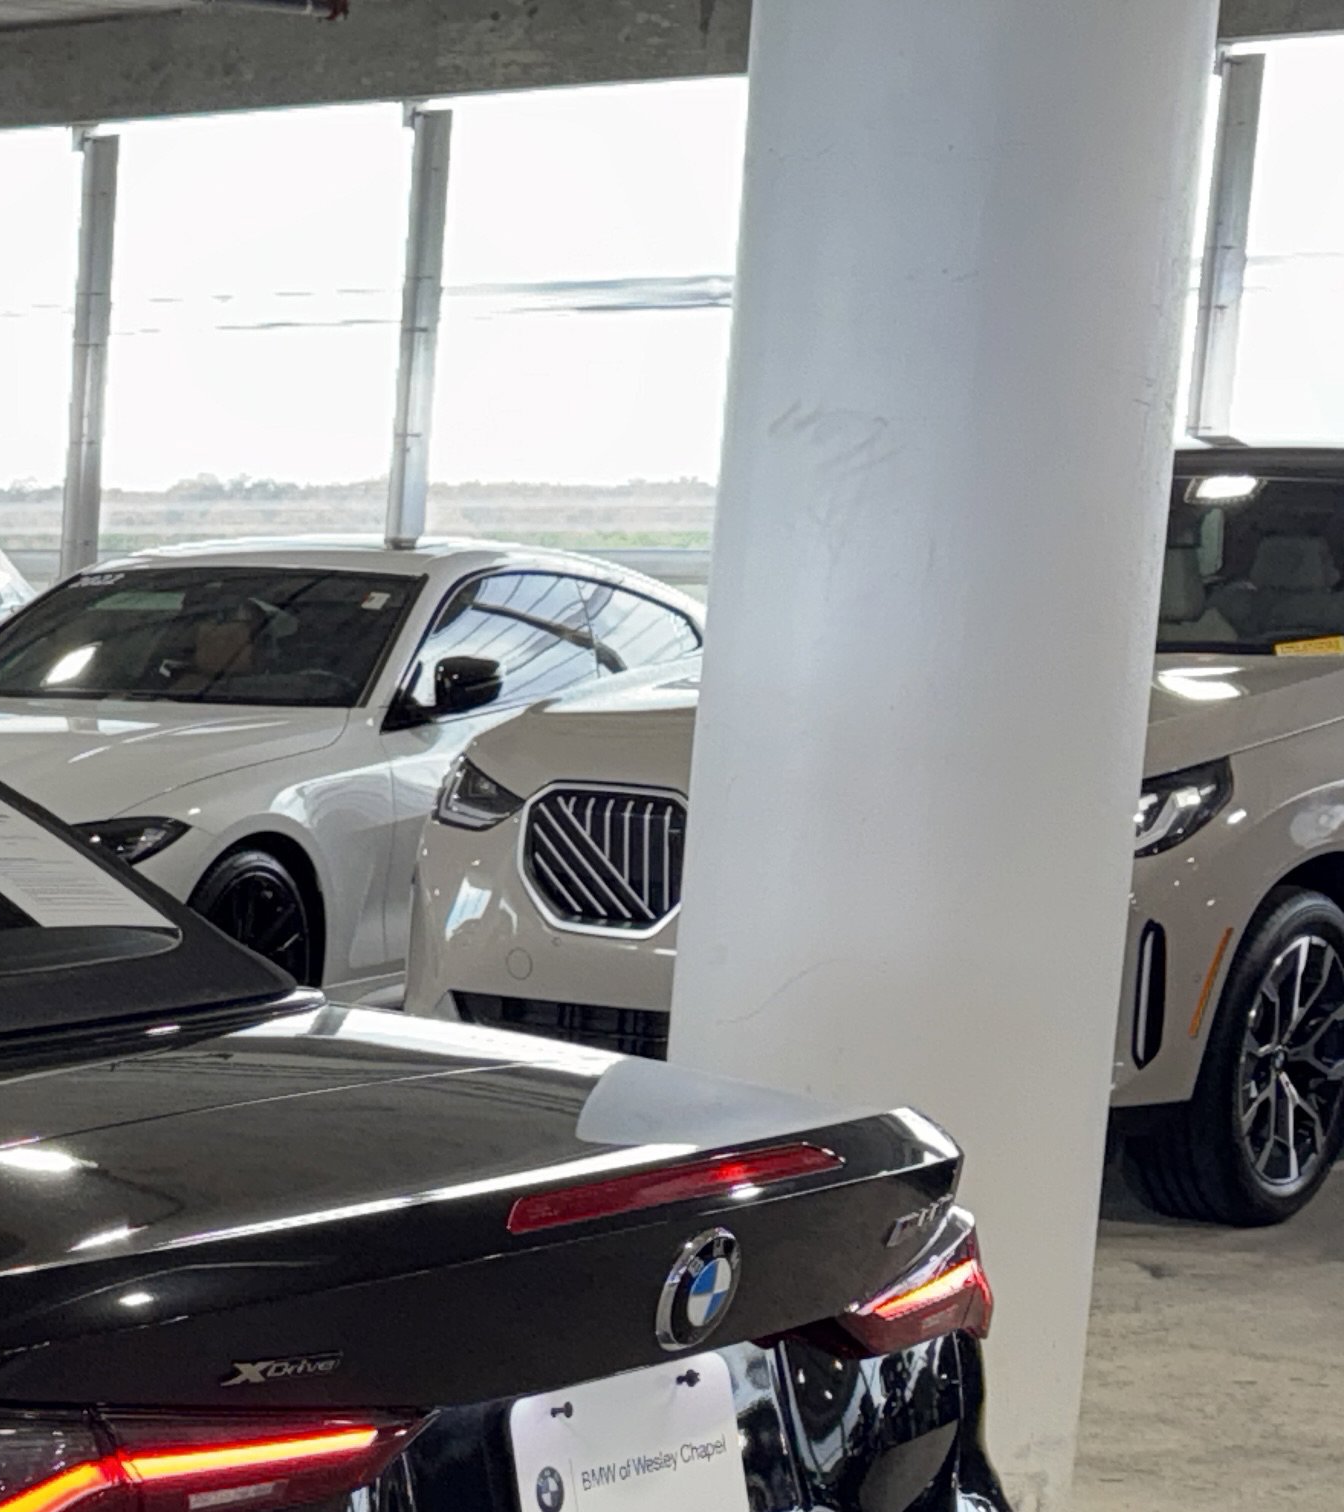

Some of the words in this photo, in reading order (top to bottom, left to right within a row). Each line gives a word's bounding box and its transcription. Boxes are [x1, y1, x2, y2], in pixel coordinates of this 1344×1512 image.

[581, 1464, 617, 1491] BMW
[619, 1458, 632, 1481] of
[632, 1450, 678, 1476] Wesley
[680, 1434, 728, 1463] Chapel
